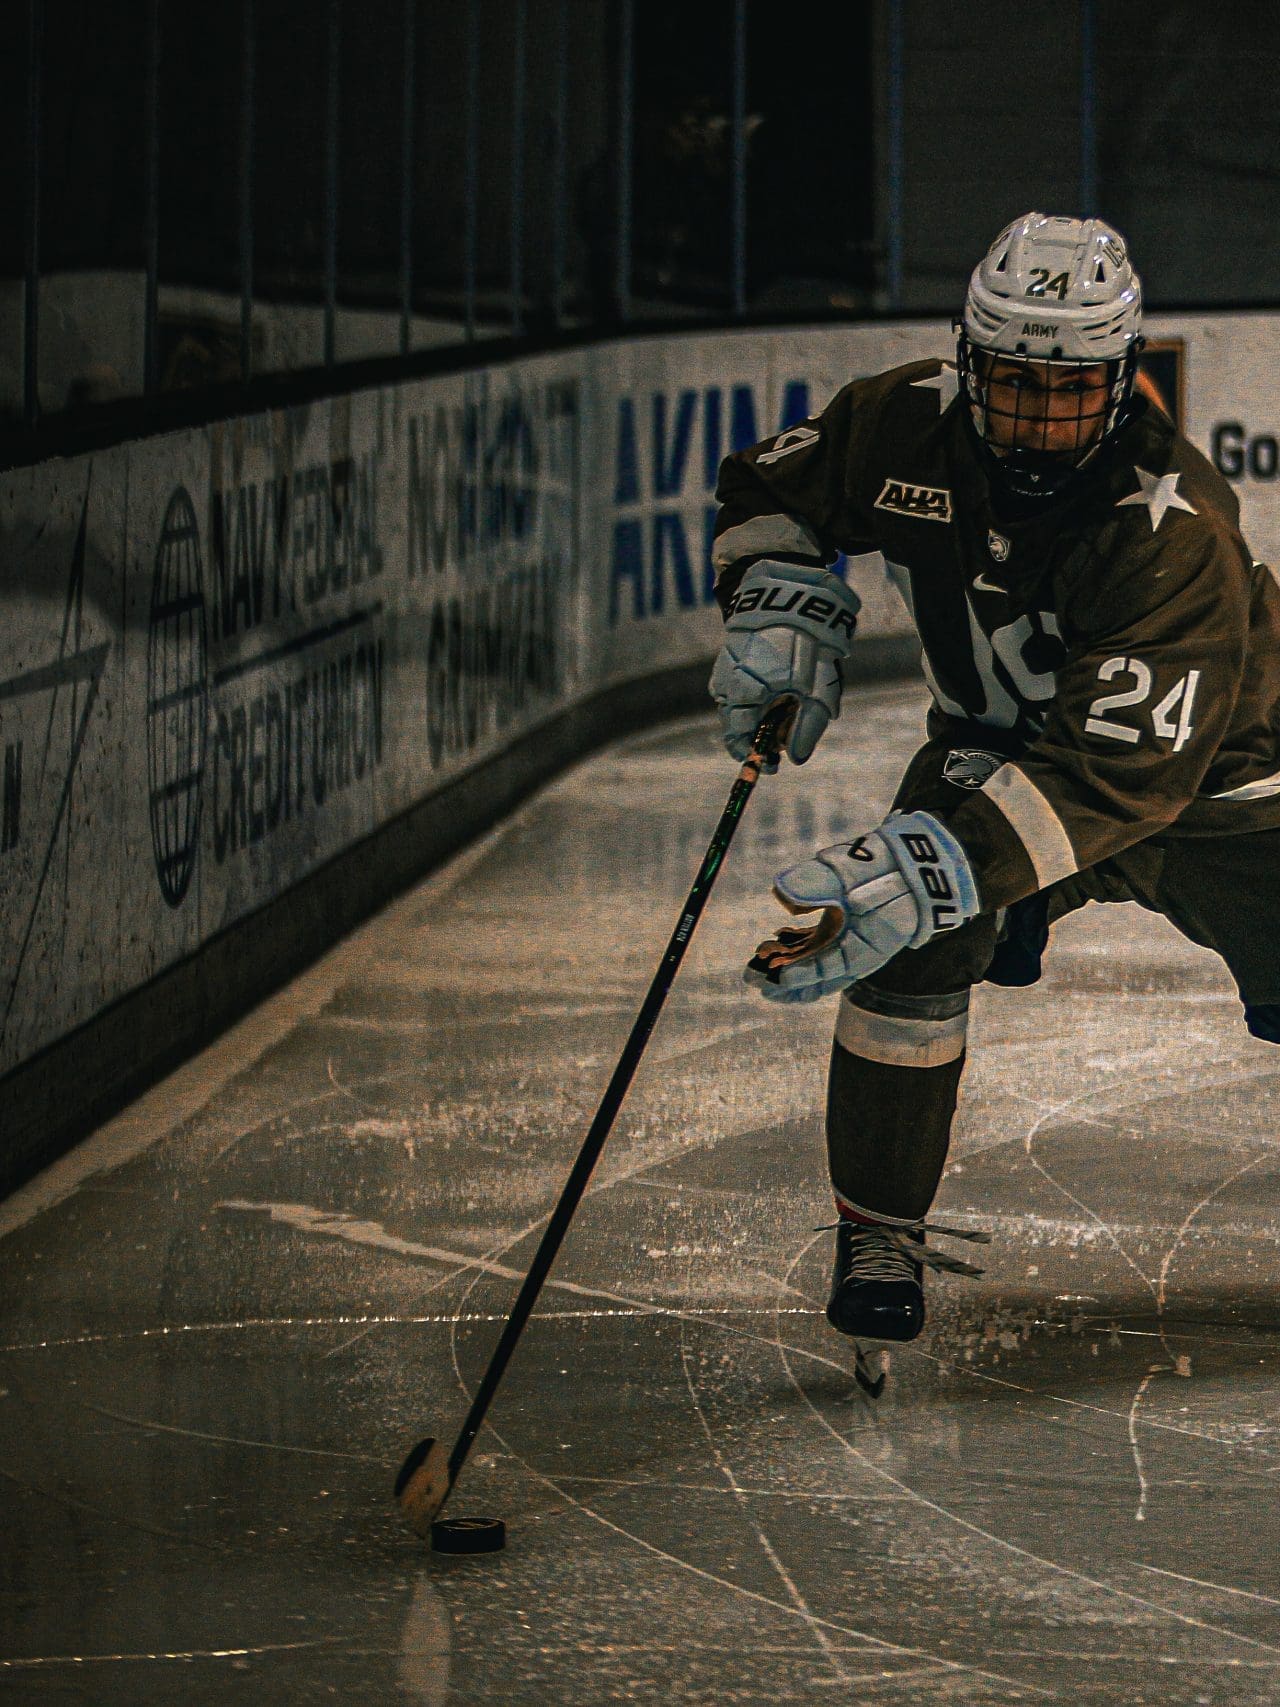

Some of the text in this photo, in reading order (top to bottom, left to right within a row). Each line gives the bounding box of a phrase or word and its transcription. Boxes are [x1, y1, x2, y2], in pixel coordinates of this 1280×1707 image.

[1025, 268, 1070, 300] 24
[1021, 323, 1059, 339] ARMY
[1084, 656, 1200, 753] 24
